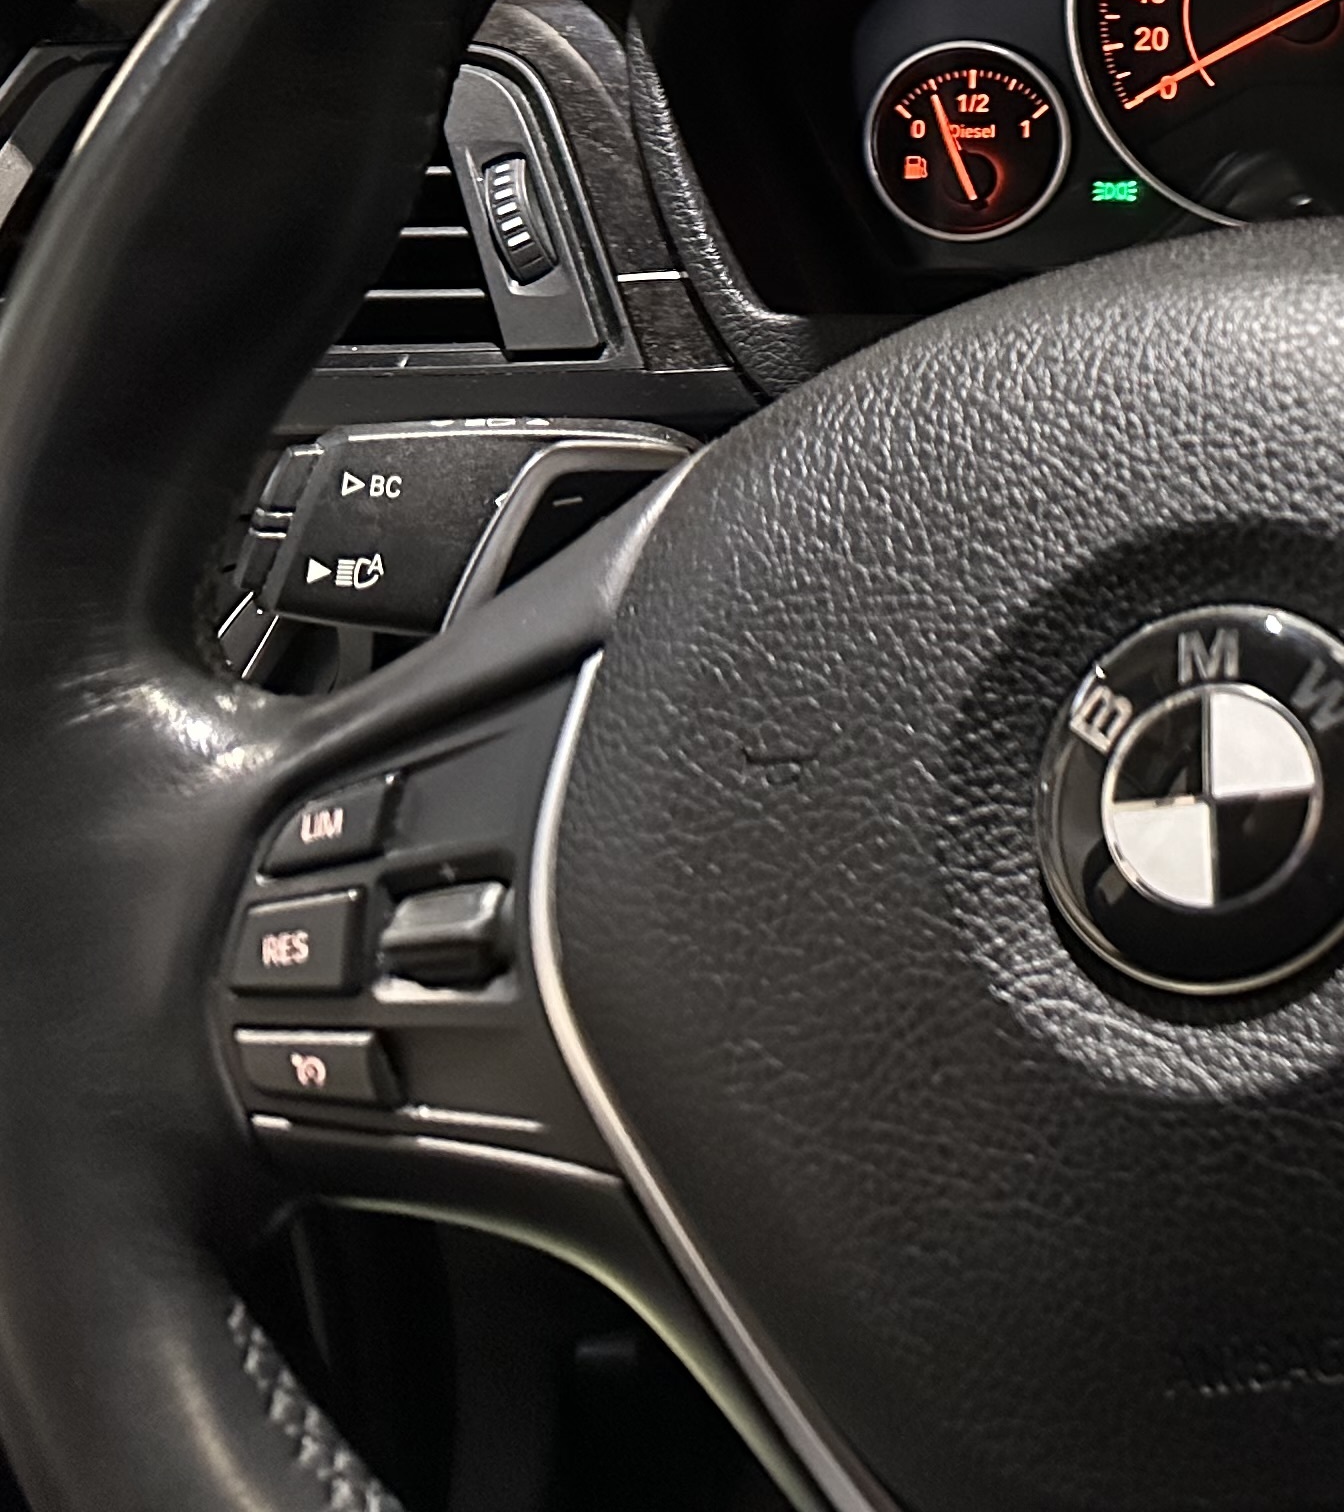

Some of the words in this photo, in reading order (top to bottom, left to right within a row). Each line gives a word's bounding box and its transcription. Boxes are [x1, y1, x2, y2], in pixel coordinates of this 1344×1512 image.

[1134, 27, 1169, 51] 20
[956, 94, 990, 112] 1/2
[911, 120, 926, 138] 0
[949, 124, 996, 139] Diesel
[1020, 120, 1031, 138] 1
[369, 474, 403, 499] BC
[262, 930, 310, 967] RES
